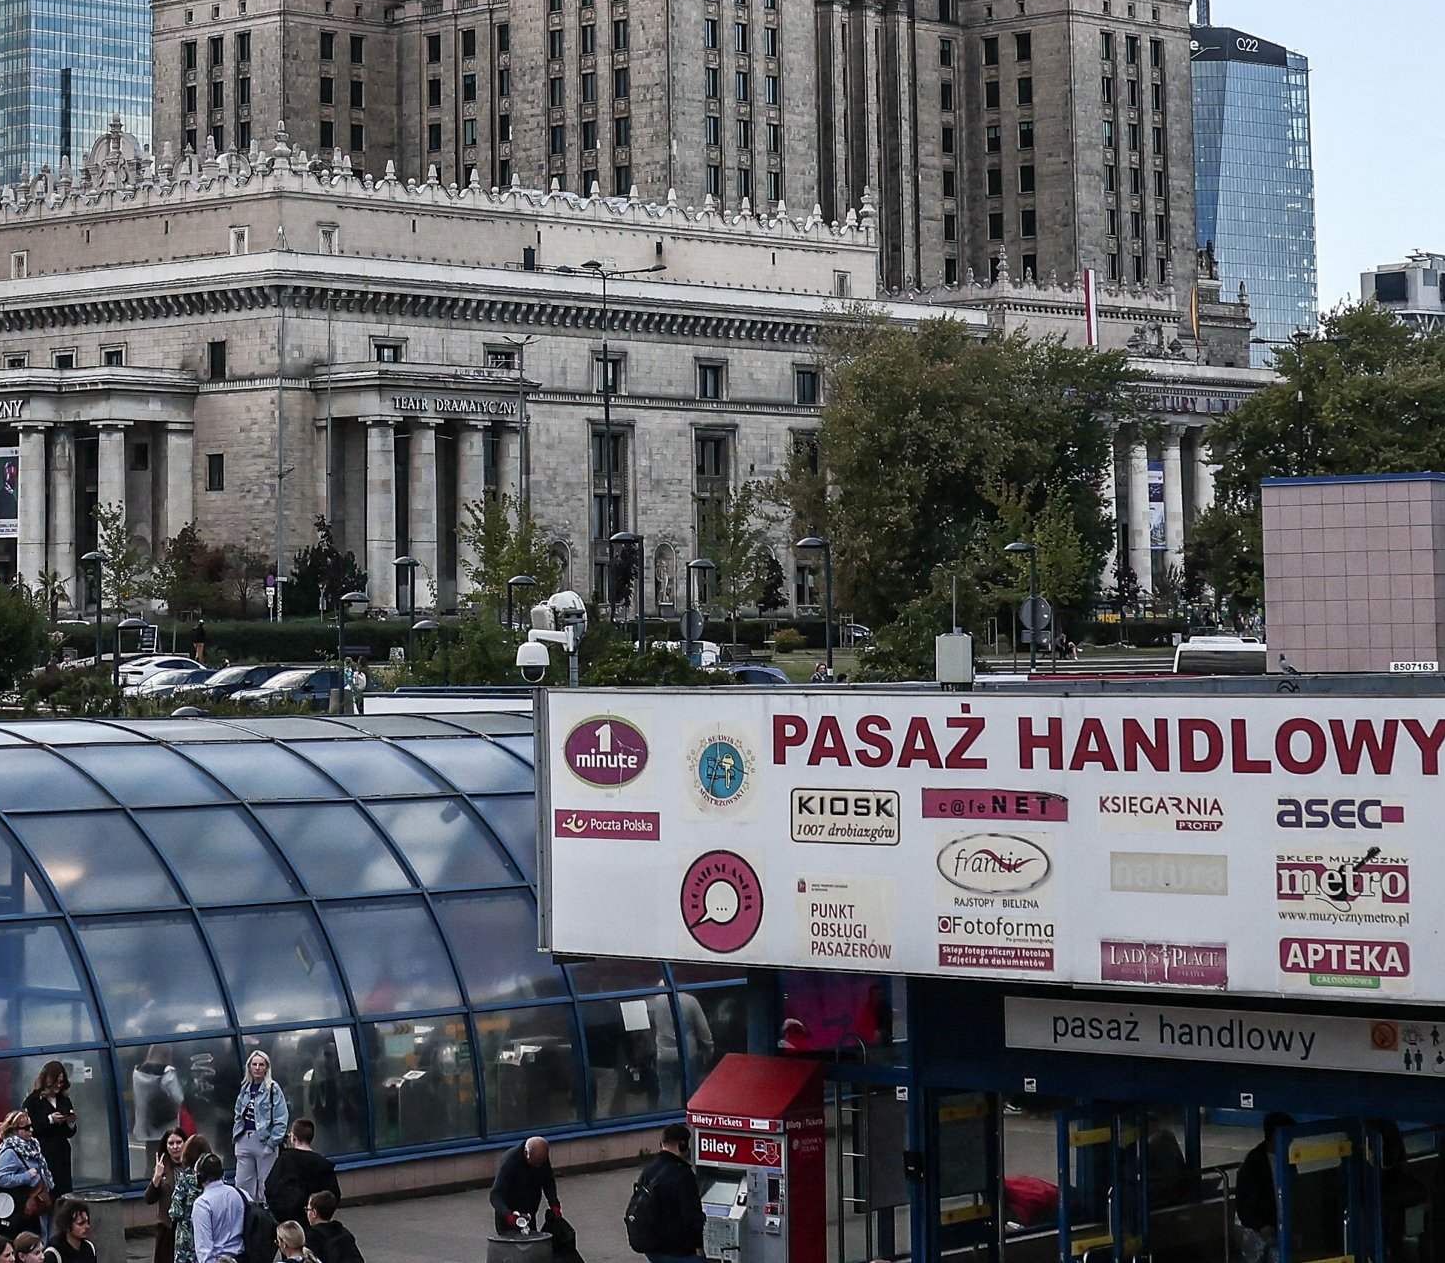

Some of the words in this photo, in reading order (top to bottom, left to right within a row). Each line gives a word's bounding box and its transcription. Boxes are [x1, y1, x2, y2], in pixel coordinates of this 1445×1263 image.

[393, 396, 428, 410] TEATR
[435, 398, 518, 414] DRAMATYCZNY
[1393, 663, 1434, 671] 8507163
[595, 724, 611, 752] 1
[773, 703, 987, 770] PASAŻ
[576, 748, 638, 769] minute
[798, 796, 896, 817] KIOSK
[1099, 796, 1224, 817] KSIĘGARNIA
[1276, 799, 1382, 829] asec
[590, 819, 621, 832] Poczta
[624, 819, 653, 832] Polska
[796, 824, 825, 836] 1007
[828, 824, 896, 842] drobiazgów
[1179, 822, 1219, 830] PROFIT
[955, 849, 1022, 876] frantic
[1330, 855, 1409, 864] MUZYCZNY
[1279, 863, 1407, 897] metro
[810, 904, 855, 919] PUNKT
[954, 898, 995, 908] RAJSTOPY
[1002, 899, 1039, 909] BIELIZNA
[952, 917, 1054, 937] Fotoforma
[1279, 910, 1409, 926] www.muzycznymetro.pl
[810, 922, 867, 939] OBSŁUGI
[810, 938, 892, 959] PASAŻERÓW
[942, 946, 963, 955] Sklep
[965, 947, 1015, 957] fotograficzny
[1172, 948, 1219, 967] PLACE
[1286, 942, 1404, 972] APTEKA
[947, 956, 976, 964] Zdjęcia
[991, 958, 1045, 967] dokumentów
[1053, 1011, 1140, 1044] pasaż
[1159, 1014, 1316, 1060] handlowy
[692, 1115, 712, 1124] Bilety
[718, 1117, 742, 1127] Tickets
[701, 1138, 736, 1157] Bilety
